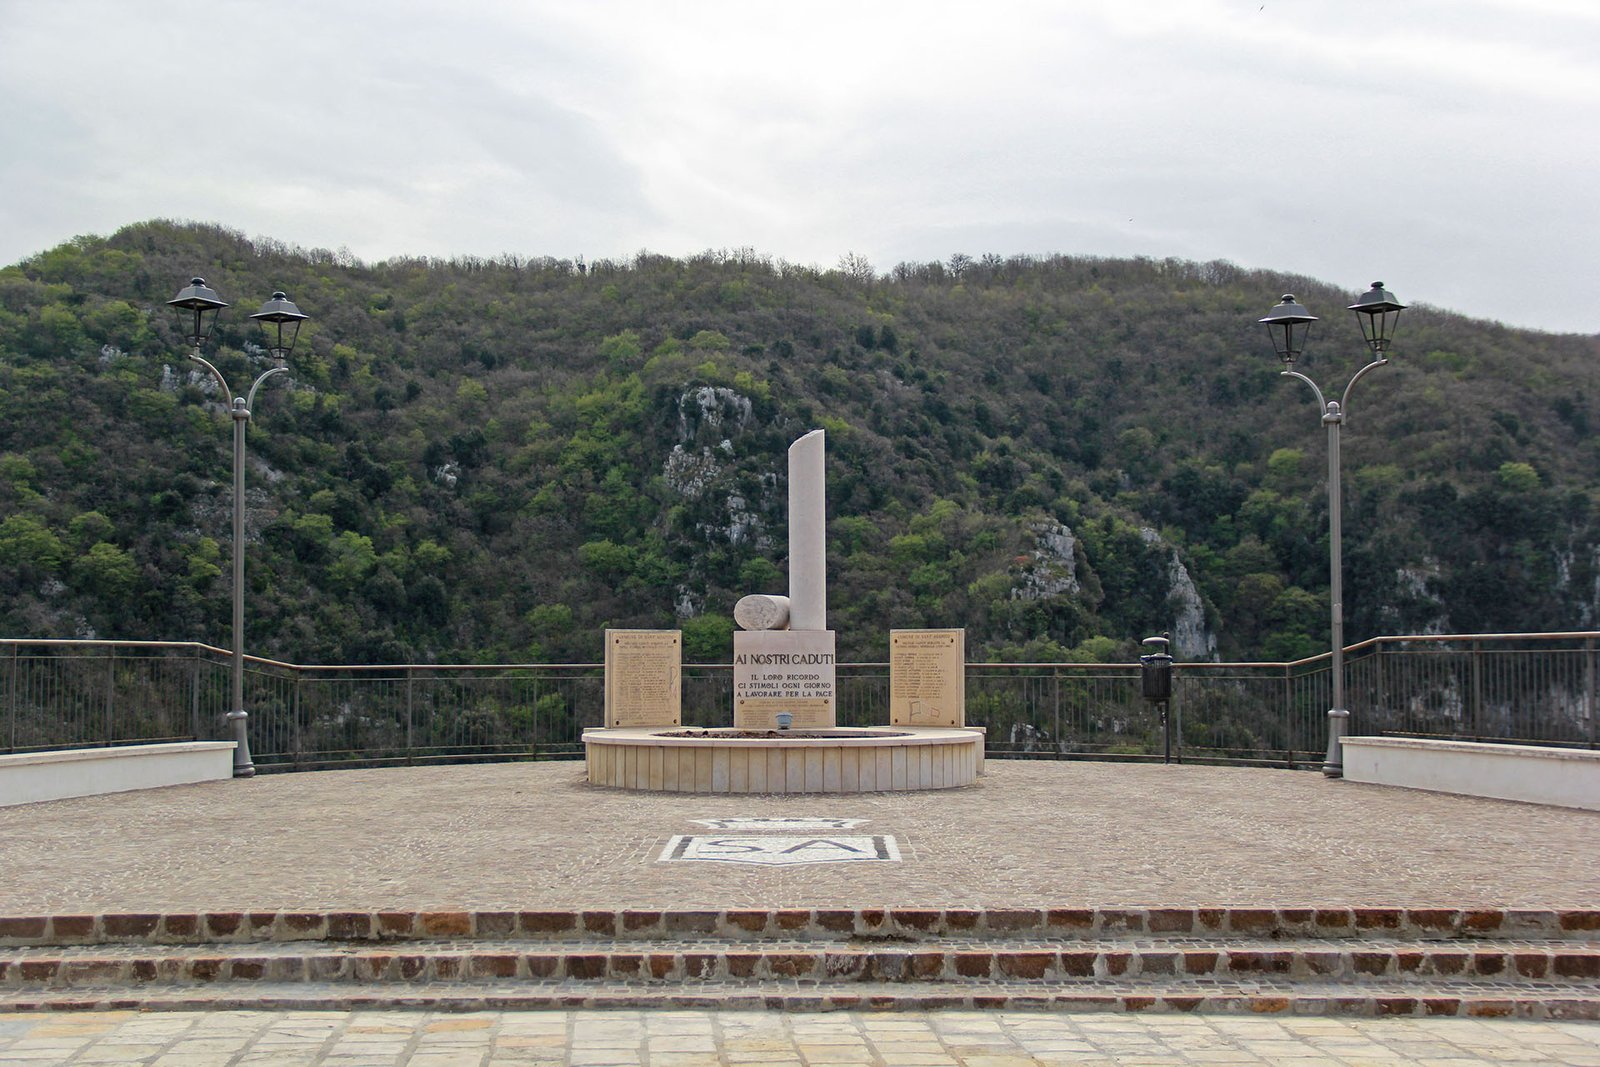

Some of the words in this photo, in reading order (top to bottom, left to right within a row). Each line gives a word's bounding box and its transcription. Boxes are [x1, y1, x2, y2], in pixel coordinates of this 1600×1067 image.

[735, 654, 747, 665] AI
[750, 654, 790, 665] NOSTRI
[791, 653, 834, 664] CADUTI
